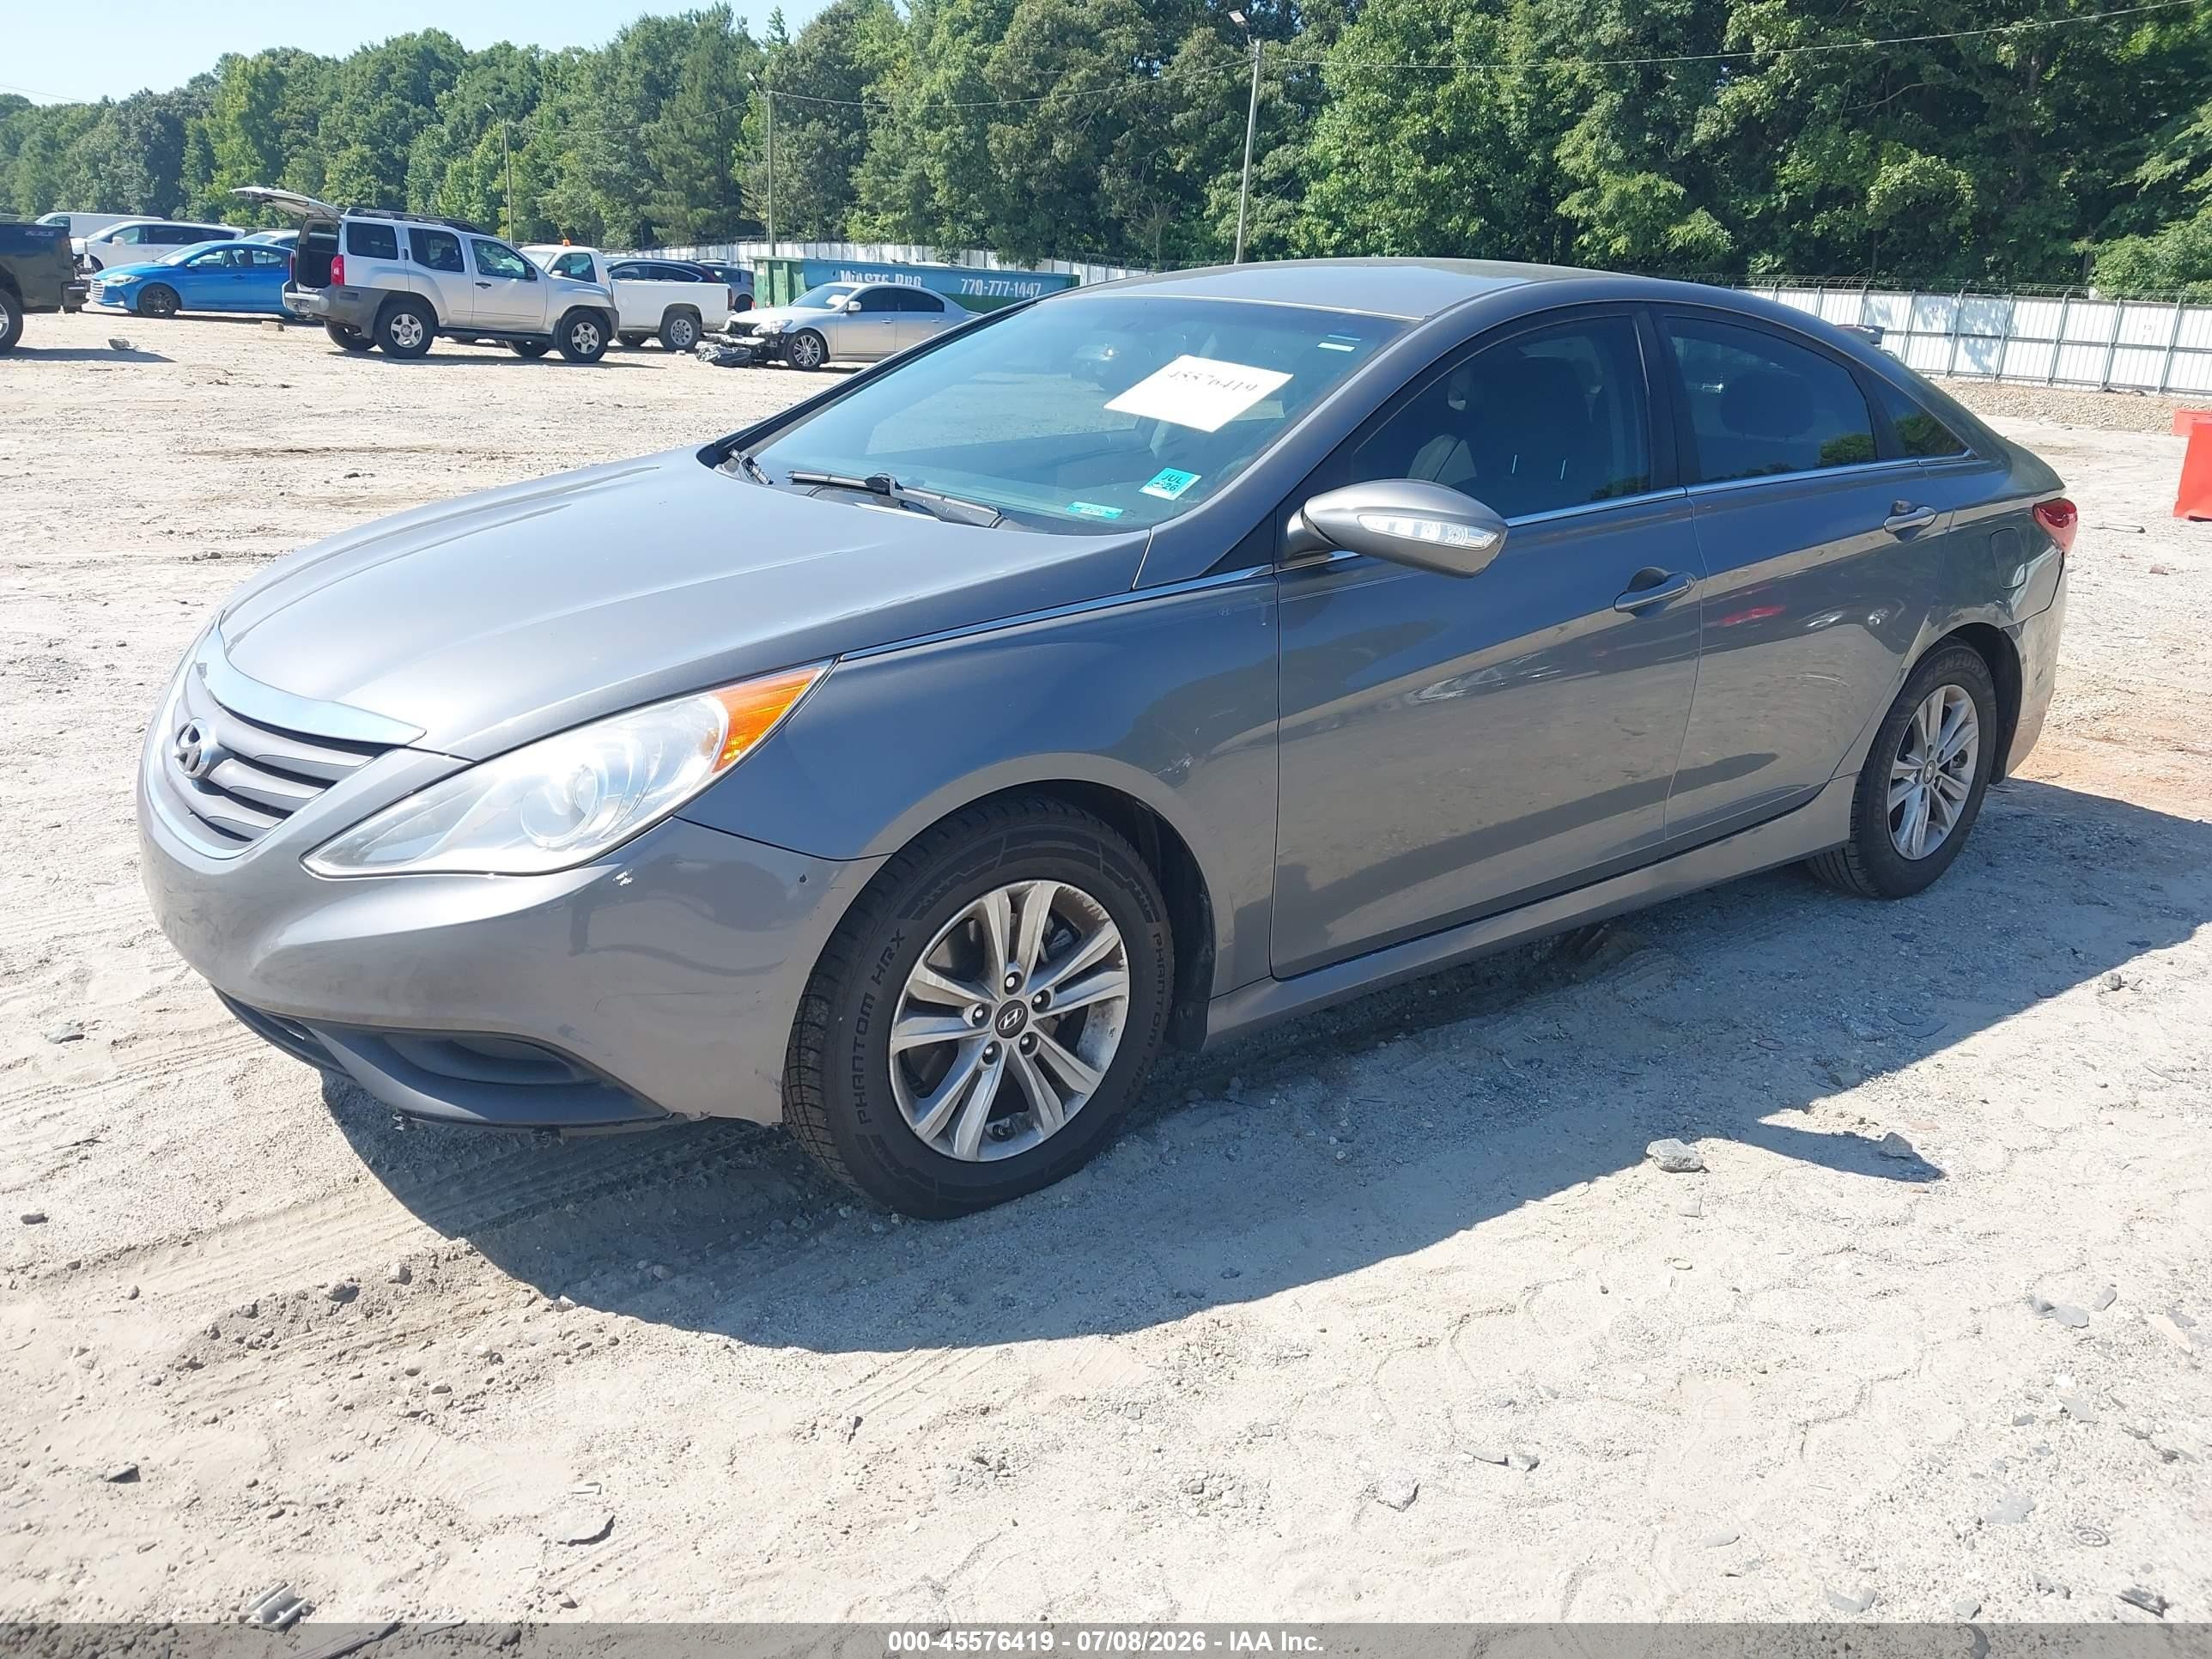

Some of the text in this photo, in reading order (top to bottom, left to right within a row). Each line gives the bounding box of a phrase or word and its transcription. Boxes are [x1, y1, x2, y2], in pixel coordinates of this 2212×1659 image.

[1161, 474, 1182, 484] JUL
[1165, 483, 1179, 492] 26
[852, 927, 906, 1125] PHANTOM HRX
